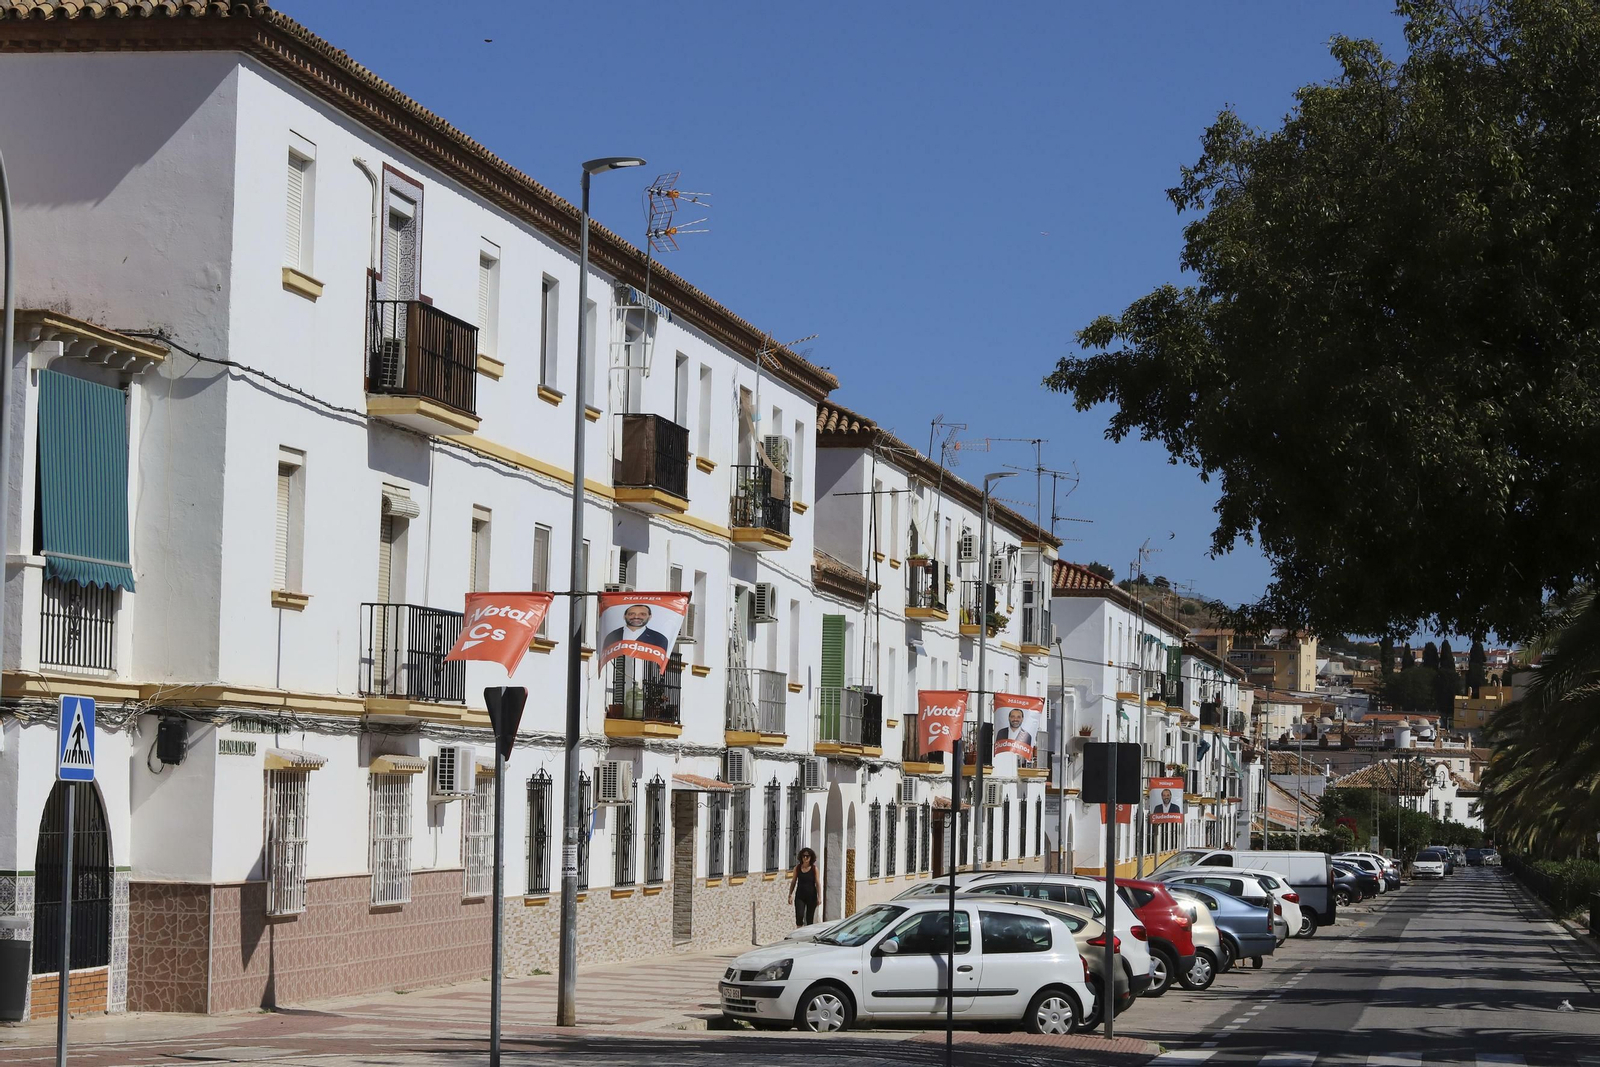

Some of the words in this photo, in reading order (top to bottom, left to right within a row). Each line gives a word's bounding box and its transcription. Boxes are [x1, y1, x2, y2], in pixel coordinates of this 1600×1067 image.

[467, 604, 535, 628] ¡Vota!
[469, 623, 507, 641] Cs
[922, 705, 962, 720] ¡Vota!
[928, 722, 950, 735] Cs
